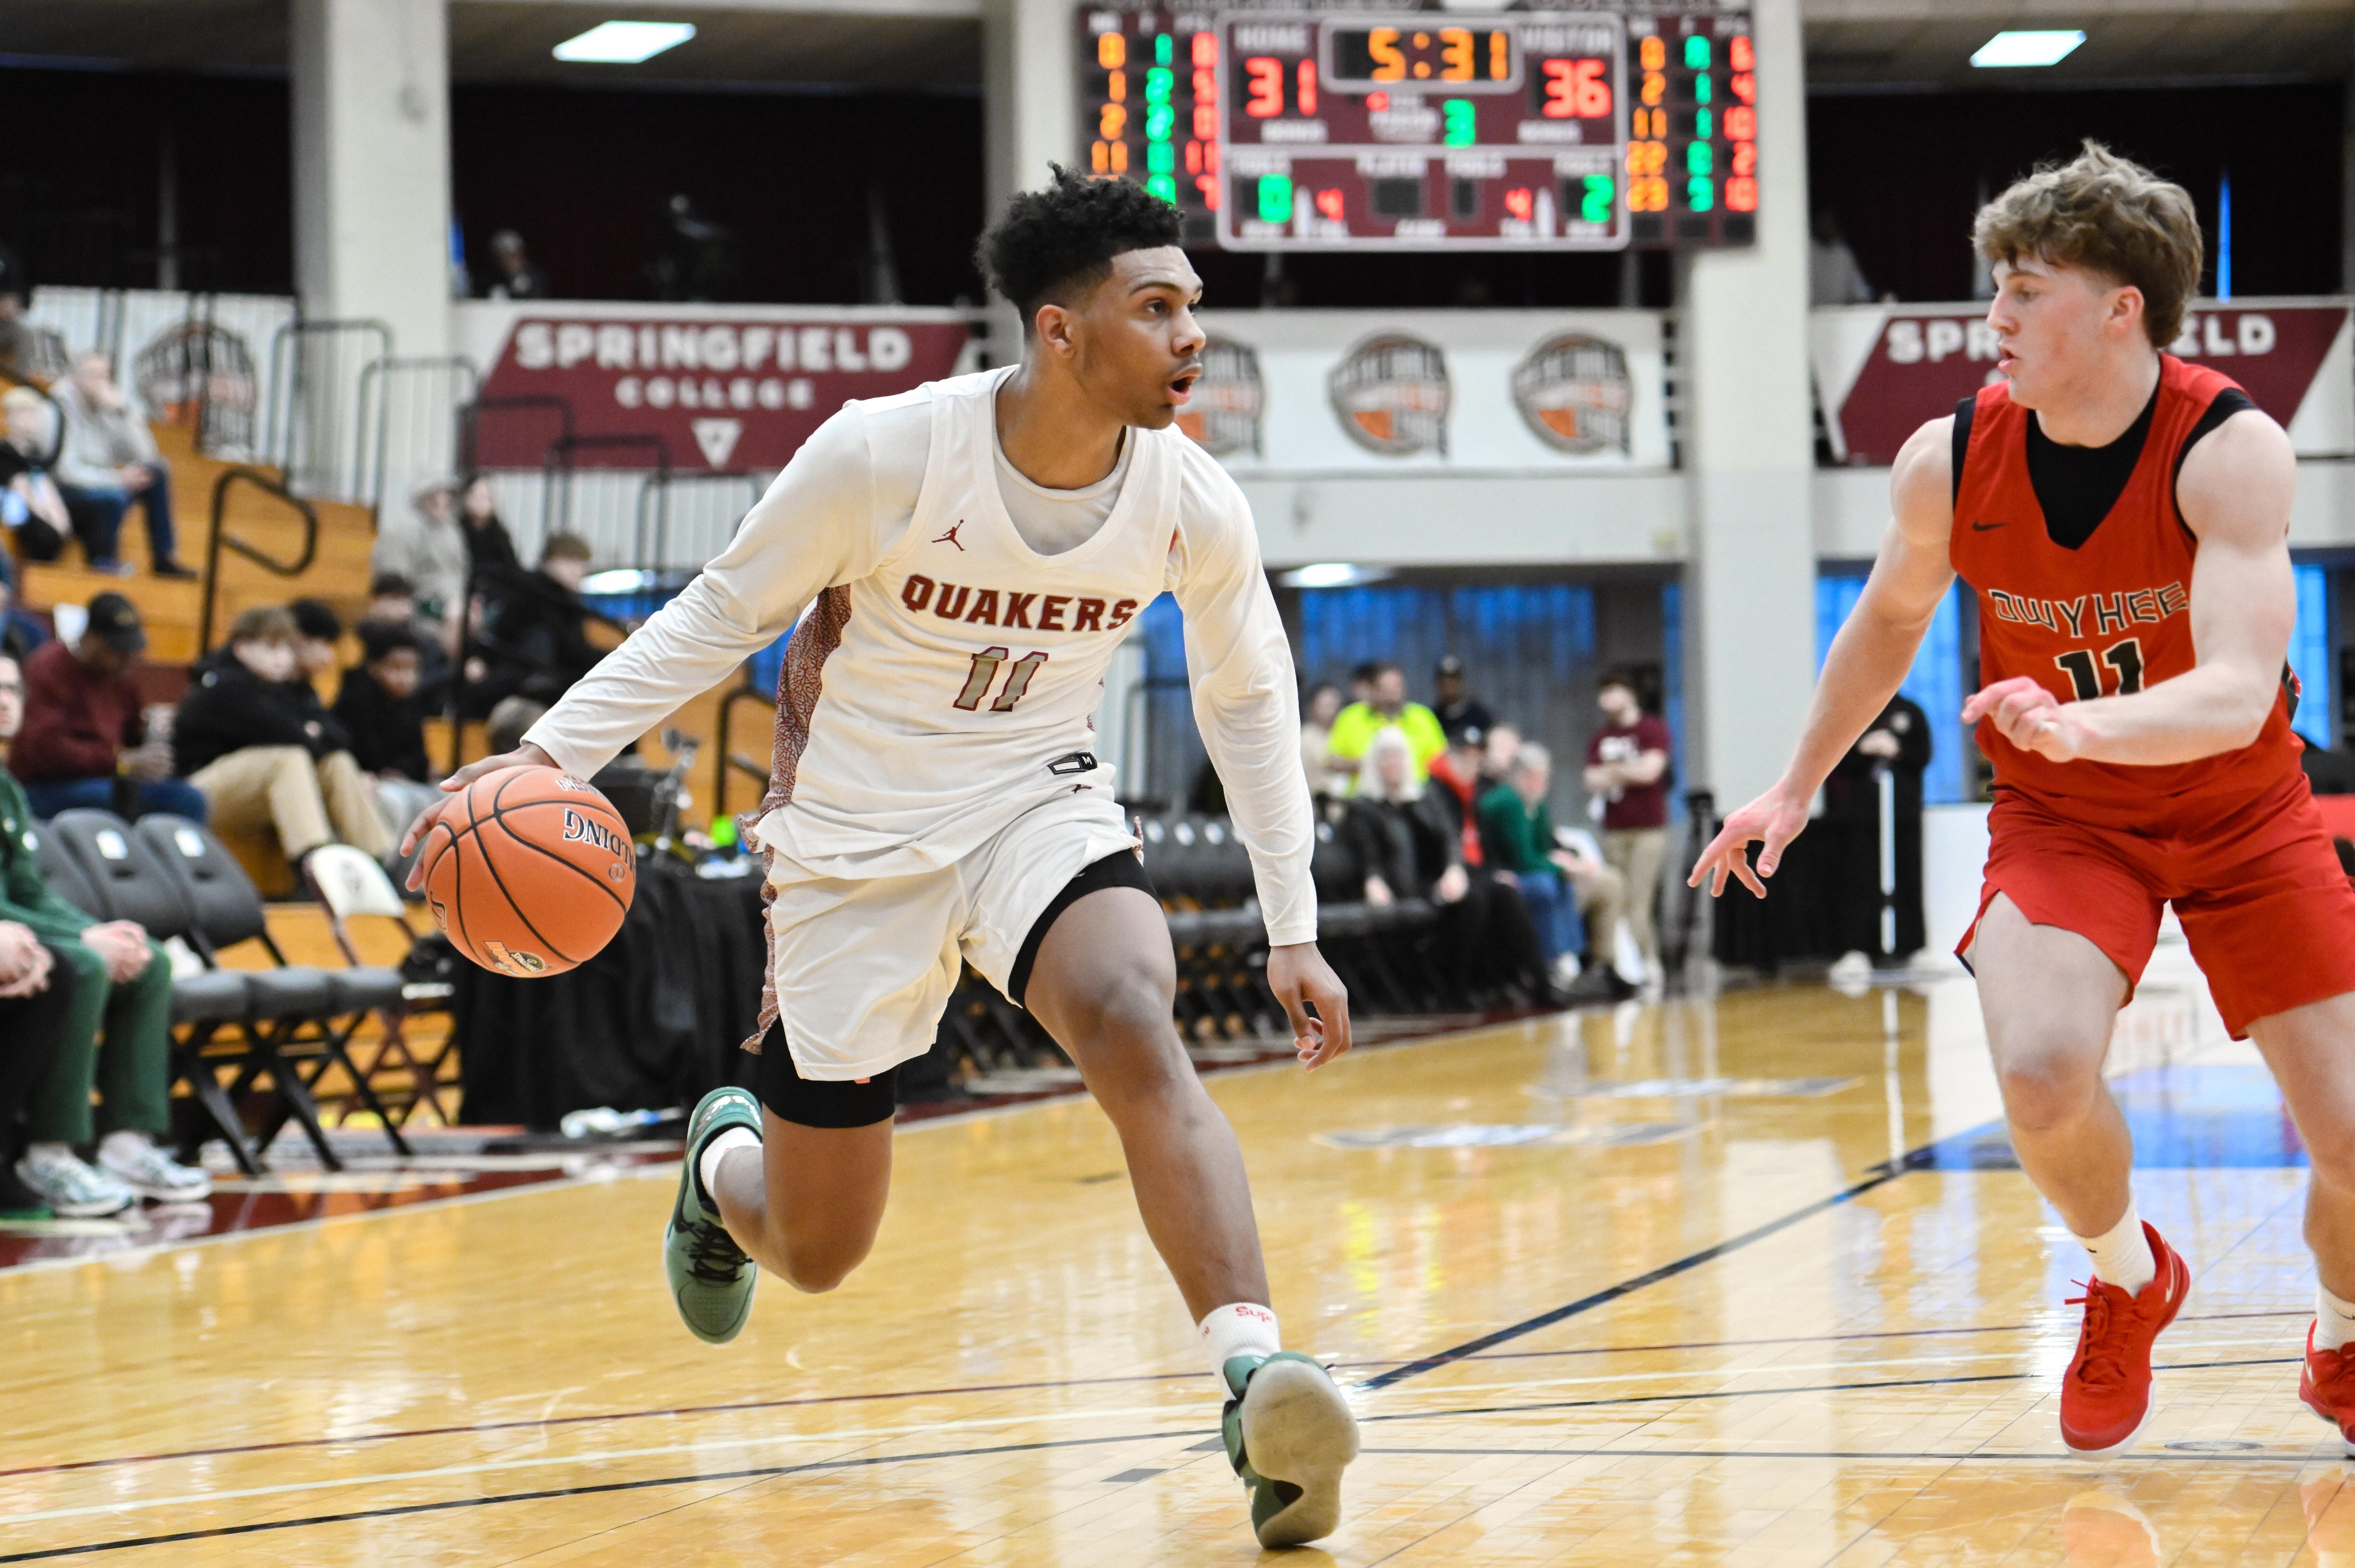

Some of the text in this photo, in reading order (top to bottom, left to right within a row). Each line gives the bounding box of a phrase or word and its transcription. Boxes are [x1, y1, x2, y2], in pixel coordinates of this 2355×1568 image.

[1368, 27, 1507, 82] 5:31
[1245, 57, 1317, 118] 31
[1543, 58, 1612, 118] 36
[1443, 99, 1476, 148] 3
[1258, 173, 1292, 224] 0
[1582, 174, 1614, 223] 2
[515, 323, 912, 372] SPRINGFIELD
[1887, 314, 2276, 364] SPRELD
[614, 377, 814, 410] COLLEGE
[900, 573, 1138, 633] QUAKERS
[1988, 581, 2189, 637] OWYHEE
[952, 646, 1049, 712] 11
[2053, 637, 2144, 702] 11
[1081, 756, 1093, 765] M
